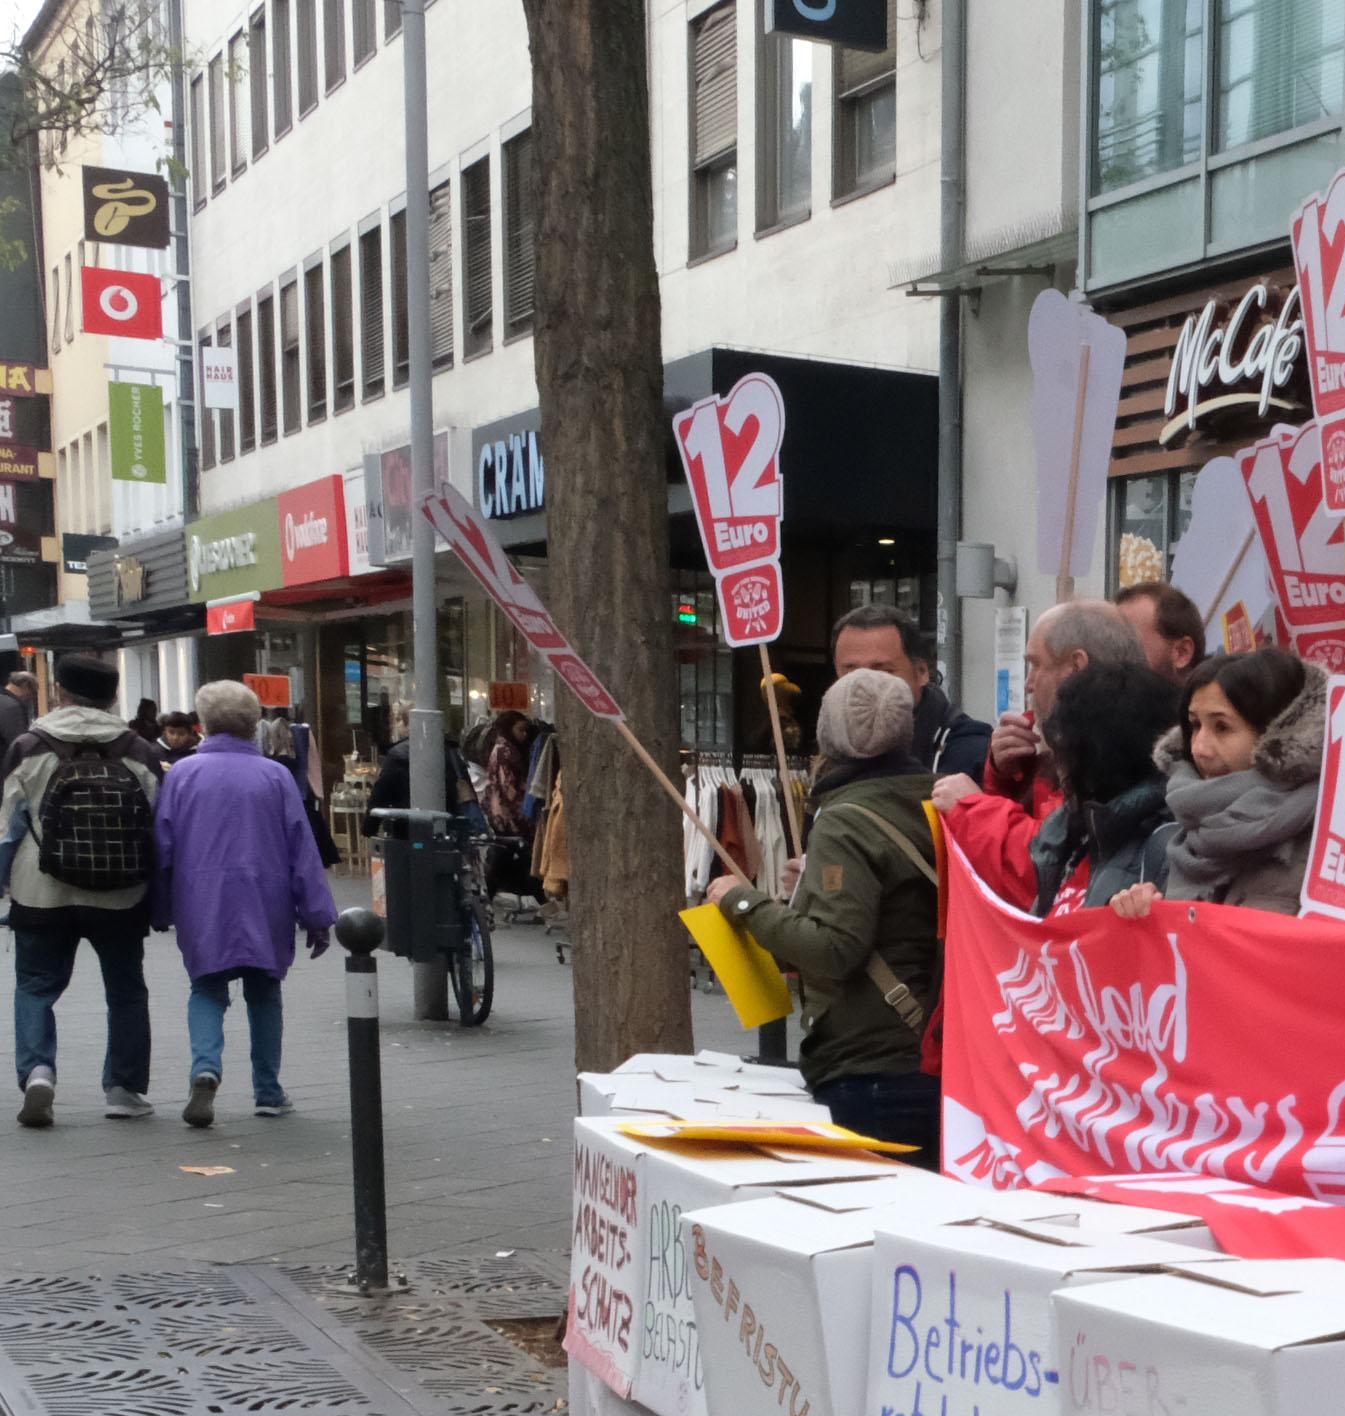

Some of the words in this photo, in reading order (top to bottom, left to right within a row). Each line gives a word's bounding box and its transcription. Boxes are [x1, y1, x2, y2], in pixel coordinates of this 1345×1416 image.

[684, 378, 780, 518] 12
[713, 521, 769, 552] Euro
[573, 1201, 632, 1271] ARBEITS-
[648, 1200, 693, 1308] ARB
[576, 1265, 634, 1354] SCHUTZ
[643, 1300, 705, 1391] BELASTU
[886, 1264, 1060, 1398] Betriebs-
